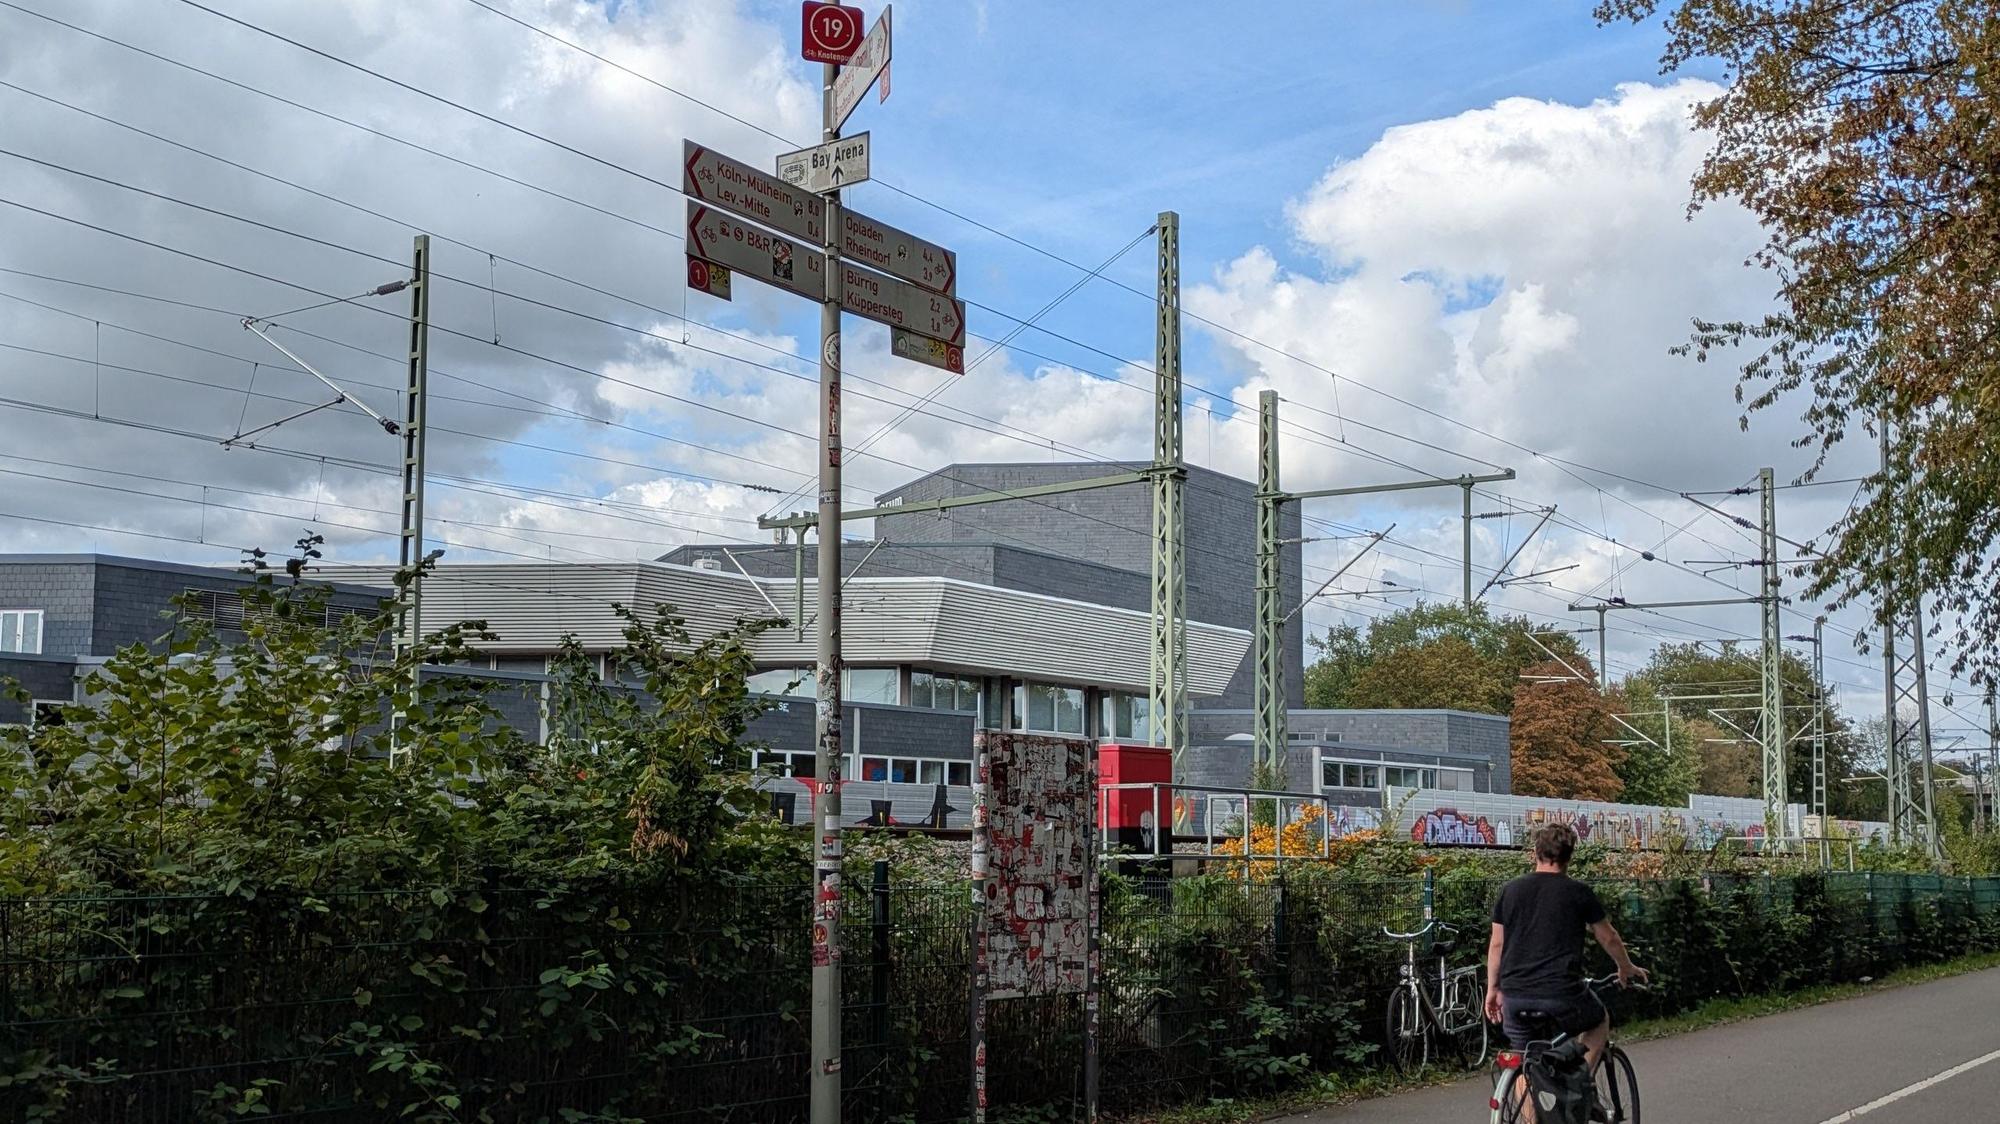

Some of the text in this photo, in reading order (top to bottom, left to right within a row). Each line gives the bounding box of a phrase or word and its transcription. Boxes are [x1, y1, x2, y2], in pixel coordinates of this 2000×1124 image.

[823, 17, 844, 38] 19
[812, 143, 864, 170] Bay Arena
[716, 160, 793, 206] Köln-Mülheim
[716, 183, 771, 218] Lev.-Mitte
[747, 231, 771, 254] B&R
[845, 216, 884, 244] Opladen
[845, 236, 891, 266] Rheindorf
[694, 268, 701, 281] 1
[846, 269, 879, 295] Bürrig
[846, 290, 903, 324] Küppersteg
[950, 354, 961, 365] 21
